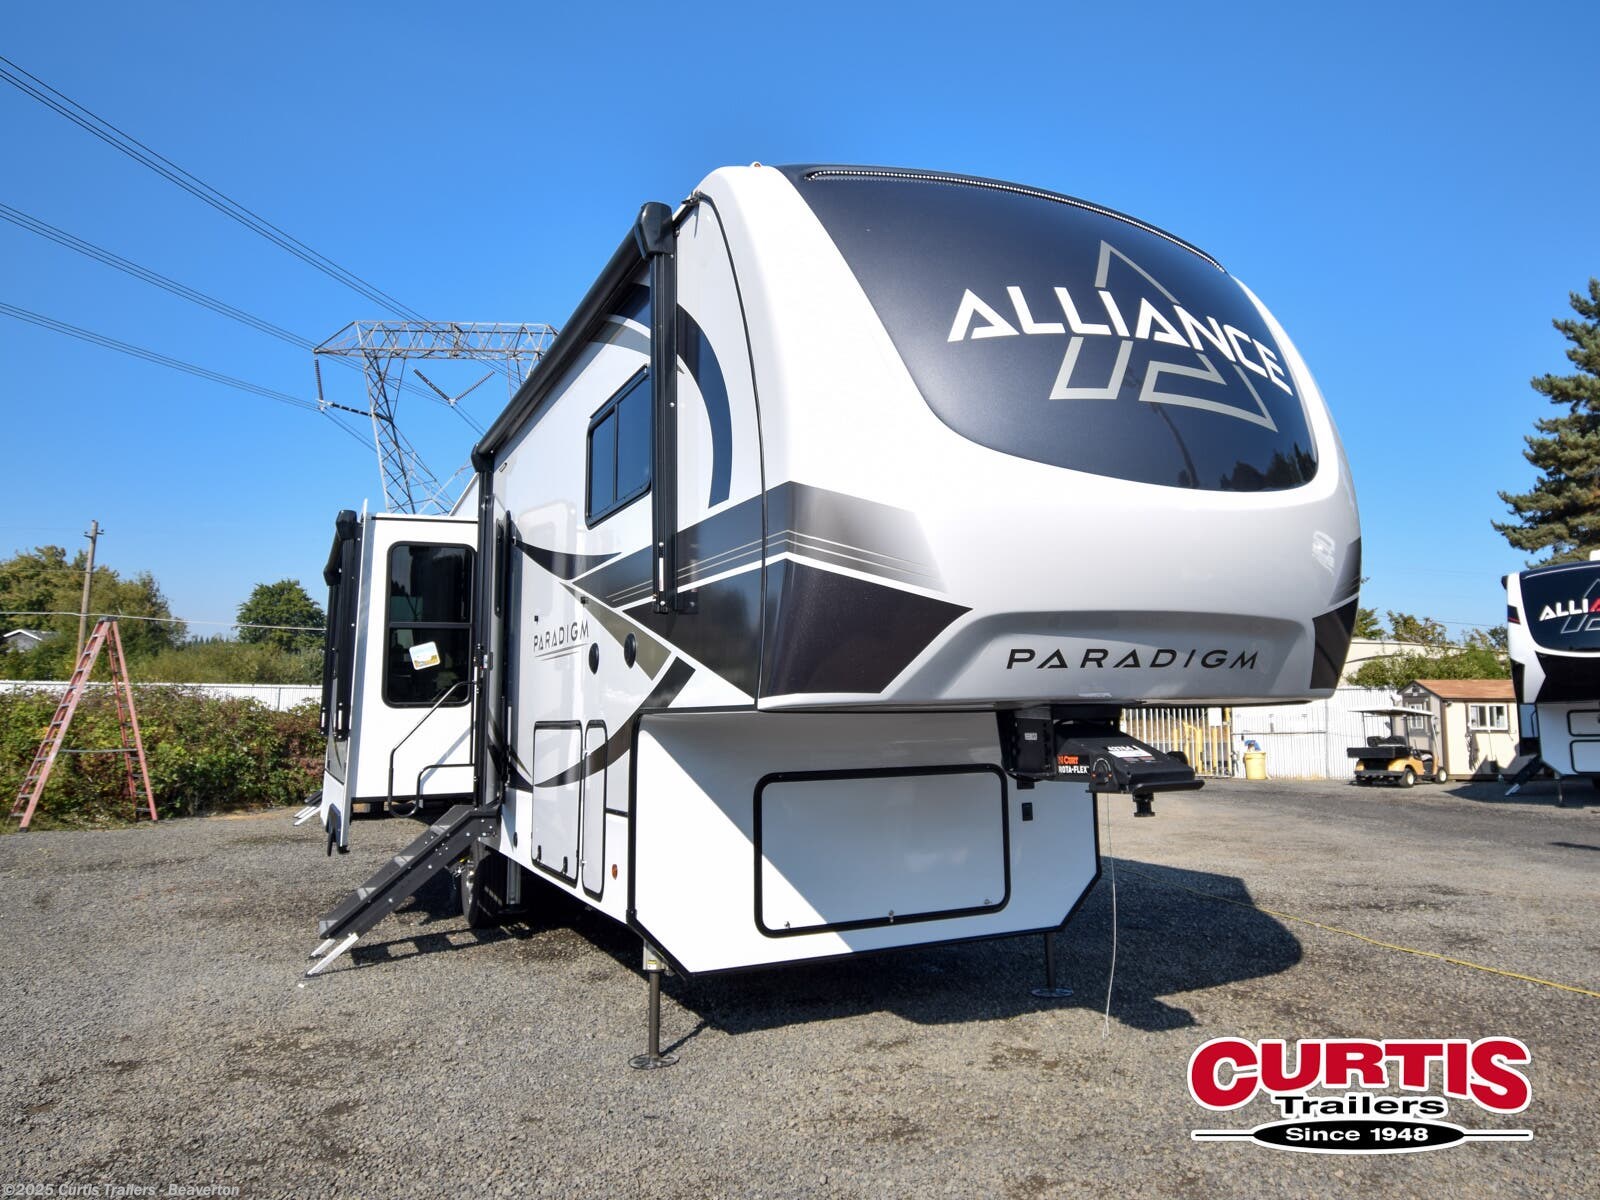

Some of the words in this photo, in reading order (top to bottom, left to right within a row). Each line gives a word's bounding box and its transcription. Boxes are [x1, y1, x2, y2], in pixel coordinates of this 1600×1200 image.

[947, 286, 1293, 396] ALLIANCE
[533, 620, 590, 652] PARADIGM
[1006, 648, 1258, 670] PARADIGM
